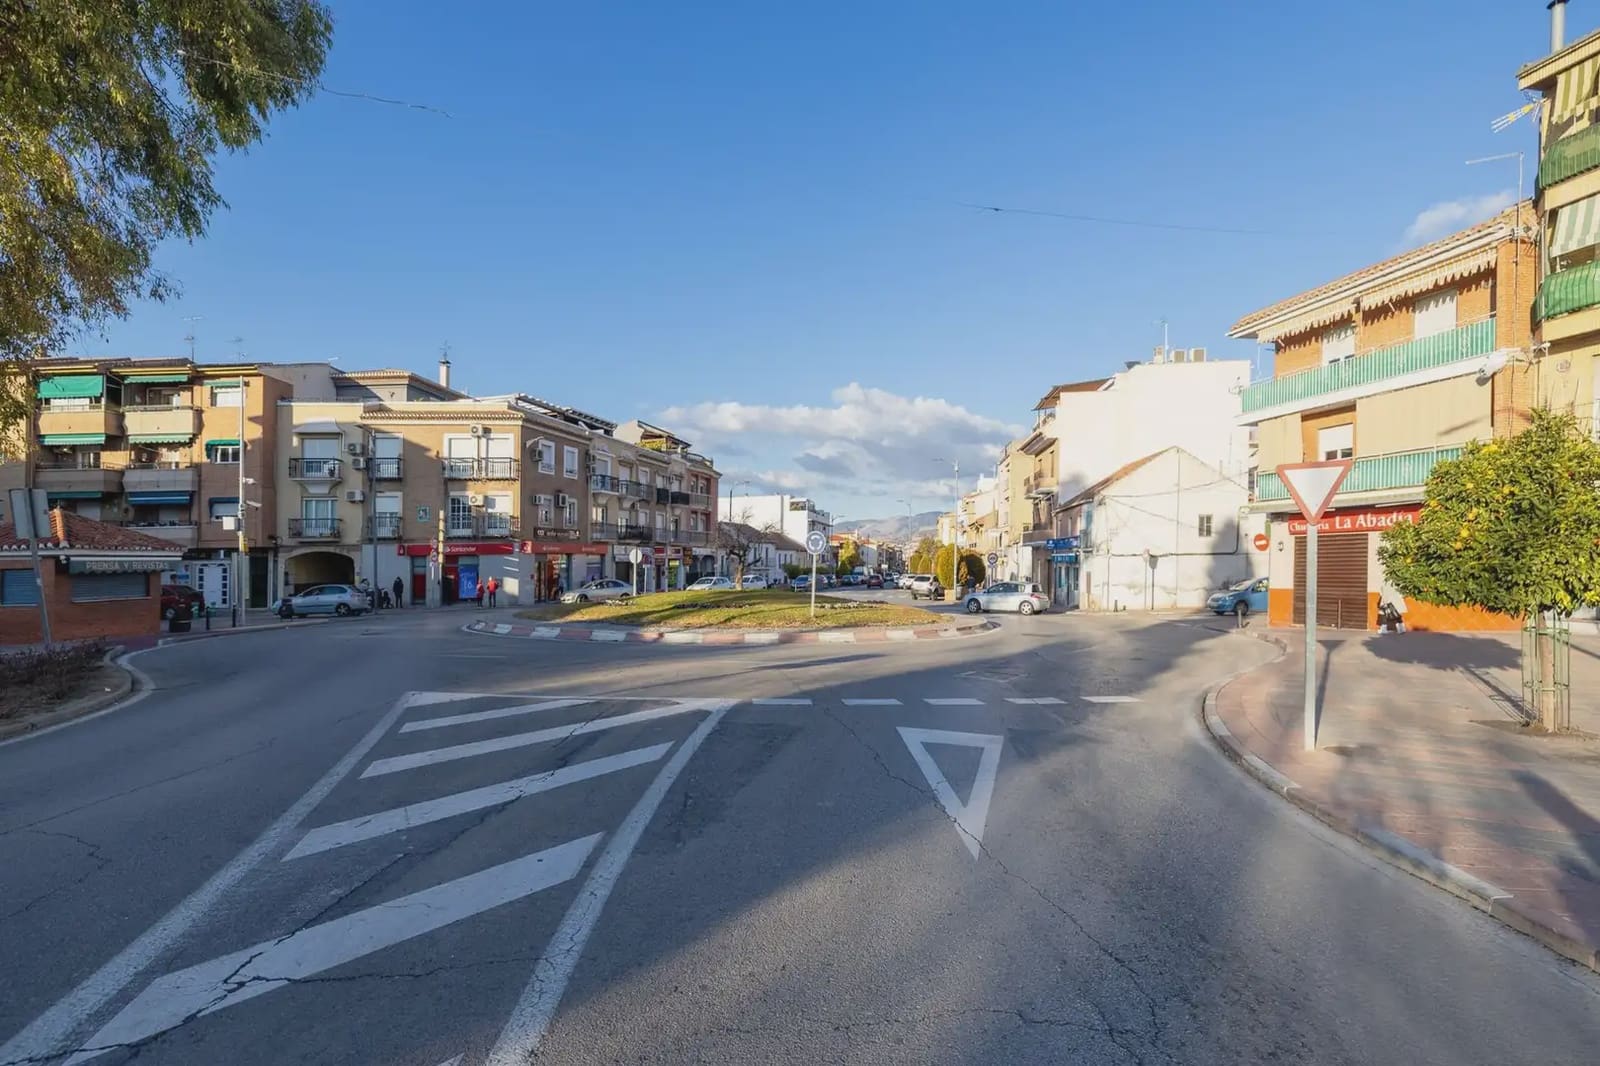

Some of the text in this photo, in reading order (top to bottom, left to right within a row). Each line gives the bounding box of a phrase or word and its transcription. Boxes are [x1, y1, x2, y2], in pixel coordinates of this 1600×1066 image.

[1335, 516, 1352, 529] La
[1355, 510, 1413, 528] Abadía
[86, 561, 119, 570] PRENSA
[132, 561, 169, 569] REVISTAS
